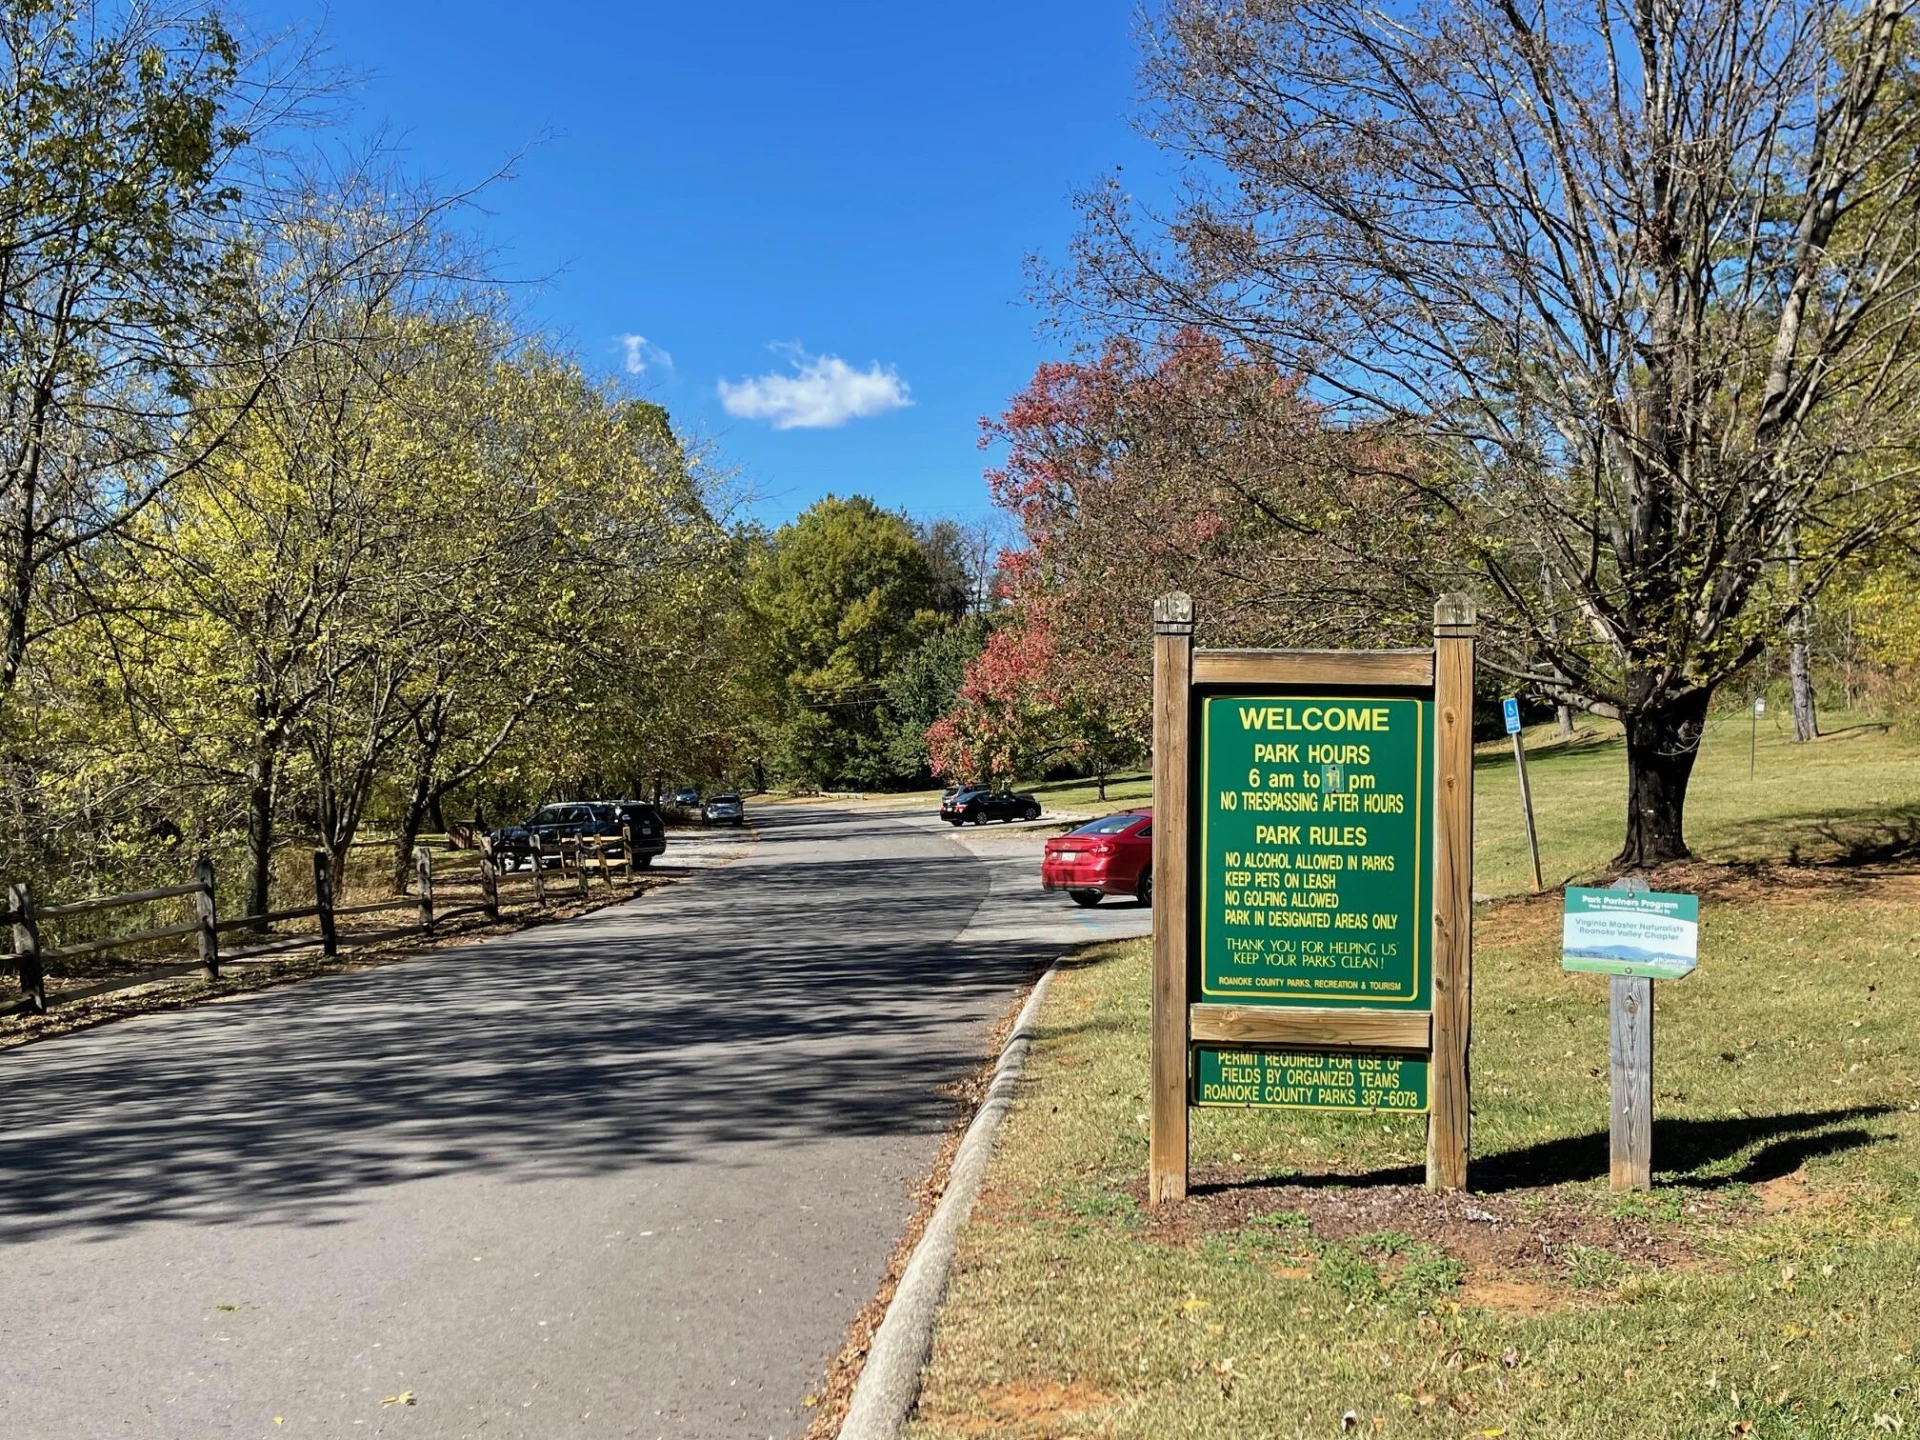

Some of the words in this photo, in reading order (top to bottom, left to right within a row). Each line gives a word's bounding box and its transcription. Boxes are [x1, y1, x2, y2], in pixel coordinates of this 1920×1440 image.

[1239, 707, 1389, 731] WELCOME
[1255, 745, 1299, 763] PARK
[1309, 745, 1370, 764] HOURS
[1249, 769, 1260, 788] 6
[1269, 773, 1294, 787] am
[1303, 770, 1320, 788] to
[1325, 770, 1340, 789] 11
[1349, 773, 1375, 791] pm
[1221, 792, 1237, 810] NO
[1242, 792, 1318, 812] TRESPASSING
[1323, 794, 1359, 812] AFTER
[1364, 794, 1403, 813] HOURS
[1256, 826, 1301, 844] PARK
[1310, 826, 1367, 846] RULES
[1226, 852, 1240, 867] NO
[1244, 853, 1291, 869] ALCOHOL
[1296, 854, 1343, 870] ALLOWED
[1348, 856, 1358, 870] IN
[1362, 856, 1395, 871] PARKS
[1225, 872, 1251, 887] KEEP
[1255, 872, 1280, 888] PETS
[1284, 873, 1299, 888] ON
[1303, 873, 1336, 889] LEASH
[1225, 891, 1240, 905] NO
[1244, 891, 1287, 907] GOLFING
[1291, 893, 1339, 908] ALLOWED
[1582, 895, 1601, 903] Park
[1604, 897, 1639, 906] Partners
[1641, 900, 1678, 910] Program
[1225, 910, 1250, 925] PARK
[1255, 911, 1264, 925] IN
[1268, 911, 1330, 928] DESIGNATED
[1335, 914, 1368, 929] AREAS
[1372, 914, 1397, 930] ONLY
[1575, 919, 1606, 928] Virginia
[1609, 920, 1637, 929] Master
[1640, 922, 1684, 933] Naturalists
[1580, 927, 1615, 936] Roanoke
[1618, 929, 1642, 938] Valley
[1645, 932, 1679, 941] Chapter
[1226, 938, 1264, 951] THANK
[1270, 940, 1296, 953] YOU
[1301, 940, 1324, 953] FOR
[1330, 942, 1376, 955] HELPING
[1382, 943, 1397, 955] US
[1234, 952, 1259, 964] KEEP
[1264, 953, 1297, 967] YOUR
[1302, 955, 1336, 968] PARKS
[1219, 977, 1252, 986] ROANOKE
[1256, 978, 1284, 987] COUNTY
[1287, 978, 1311, 988] PARKS,
[1315, 980, 1358, 989] RECREATION
[1361, 982, 1366, 990] &
[1370, 981, 1401, 990] TOURISM
[1218, 1051, 1258, 1066] PERMIT
[1265, 1052, 1324, 1068] REQUIRED
[1329, 1053, 1353, 1069] FOR
[1358, 1055, 1381, 1071] USE
[1387, 1056, 1403, 1071] OF
[1222, 1068, 1261, 1084] FIELDS
[1267, 1070, 1281, 1084] BY
[1287, 1070, 1354, 1087] ORGANIZED
[1359, 1072, 1400, 1089] TEAMS
[1204, 1084, 1260, 1101] ROANOKE
[1265, 1086, 1313, 1103] COUNTY
[1318, 1088, 1356, 1105] PARKS
[1362, 1090, 1418, 1107] 387-6078
